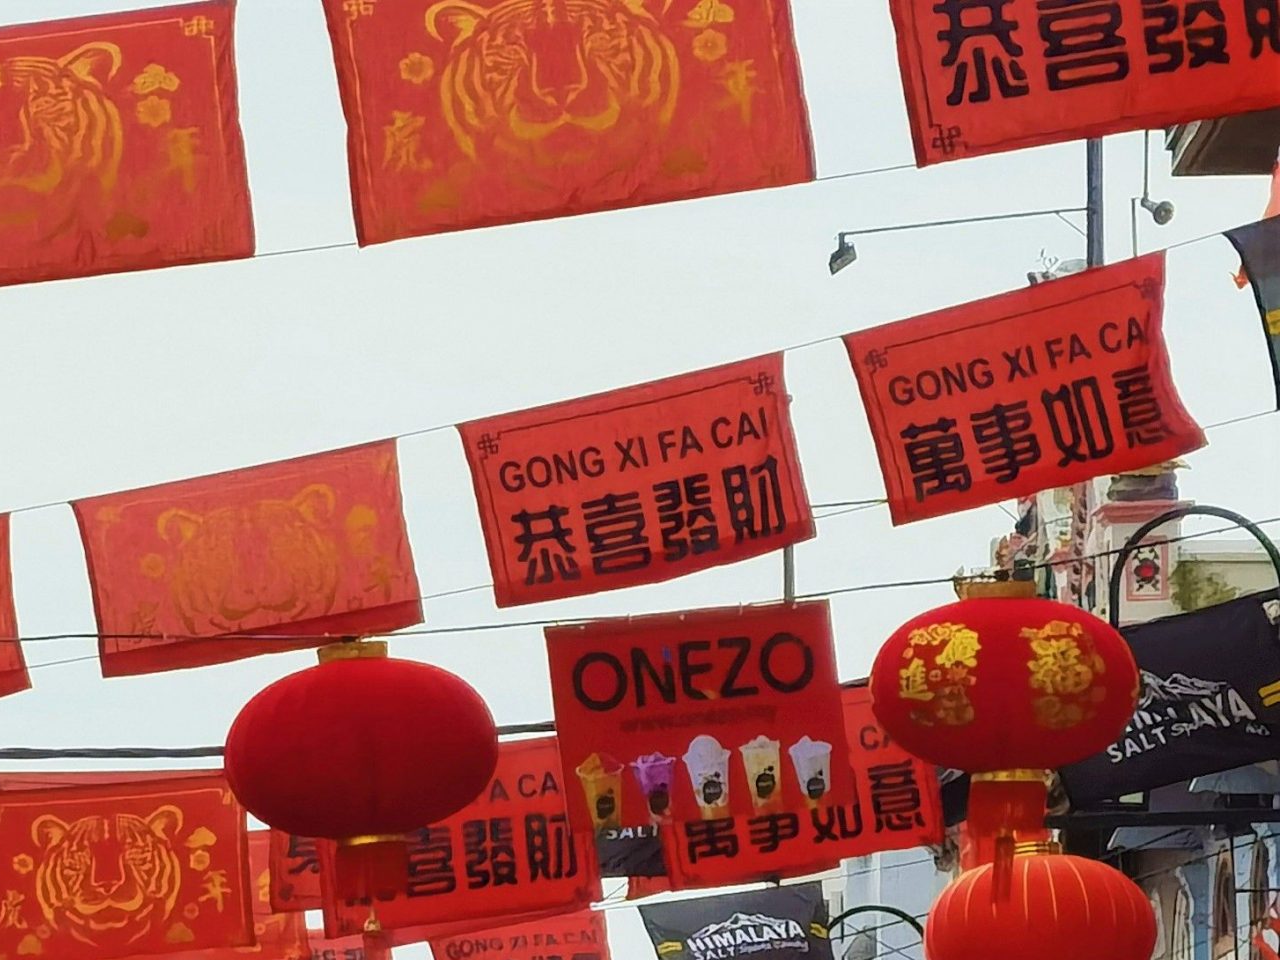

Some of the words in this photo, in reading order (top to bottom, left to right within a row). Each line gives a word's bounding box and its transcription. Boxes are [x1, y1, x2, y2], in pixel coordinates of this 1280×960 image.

[889, 359, 994, 406] GONG
[1003, 346, 1038, 382] XI
[1045, 333, 1091, 369] FA
[499, 445, 605, 494] GONG
[616, 434, 648, 469] XI
[659, 424, 703, 459] FA
[712, 406, 769, 450] CAI
[900, 363, 1167, 502] 萬事如意
[511, 454, 787, 587] 恭喜發財
[572, 632, 814, 712] ONEZO
[1106, 725, 1167, 764] SALT
[687, 920, 805, 952] HIMALAYA
